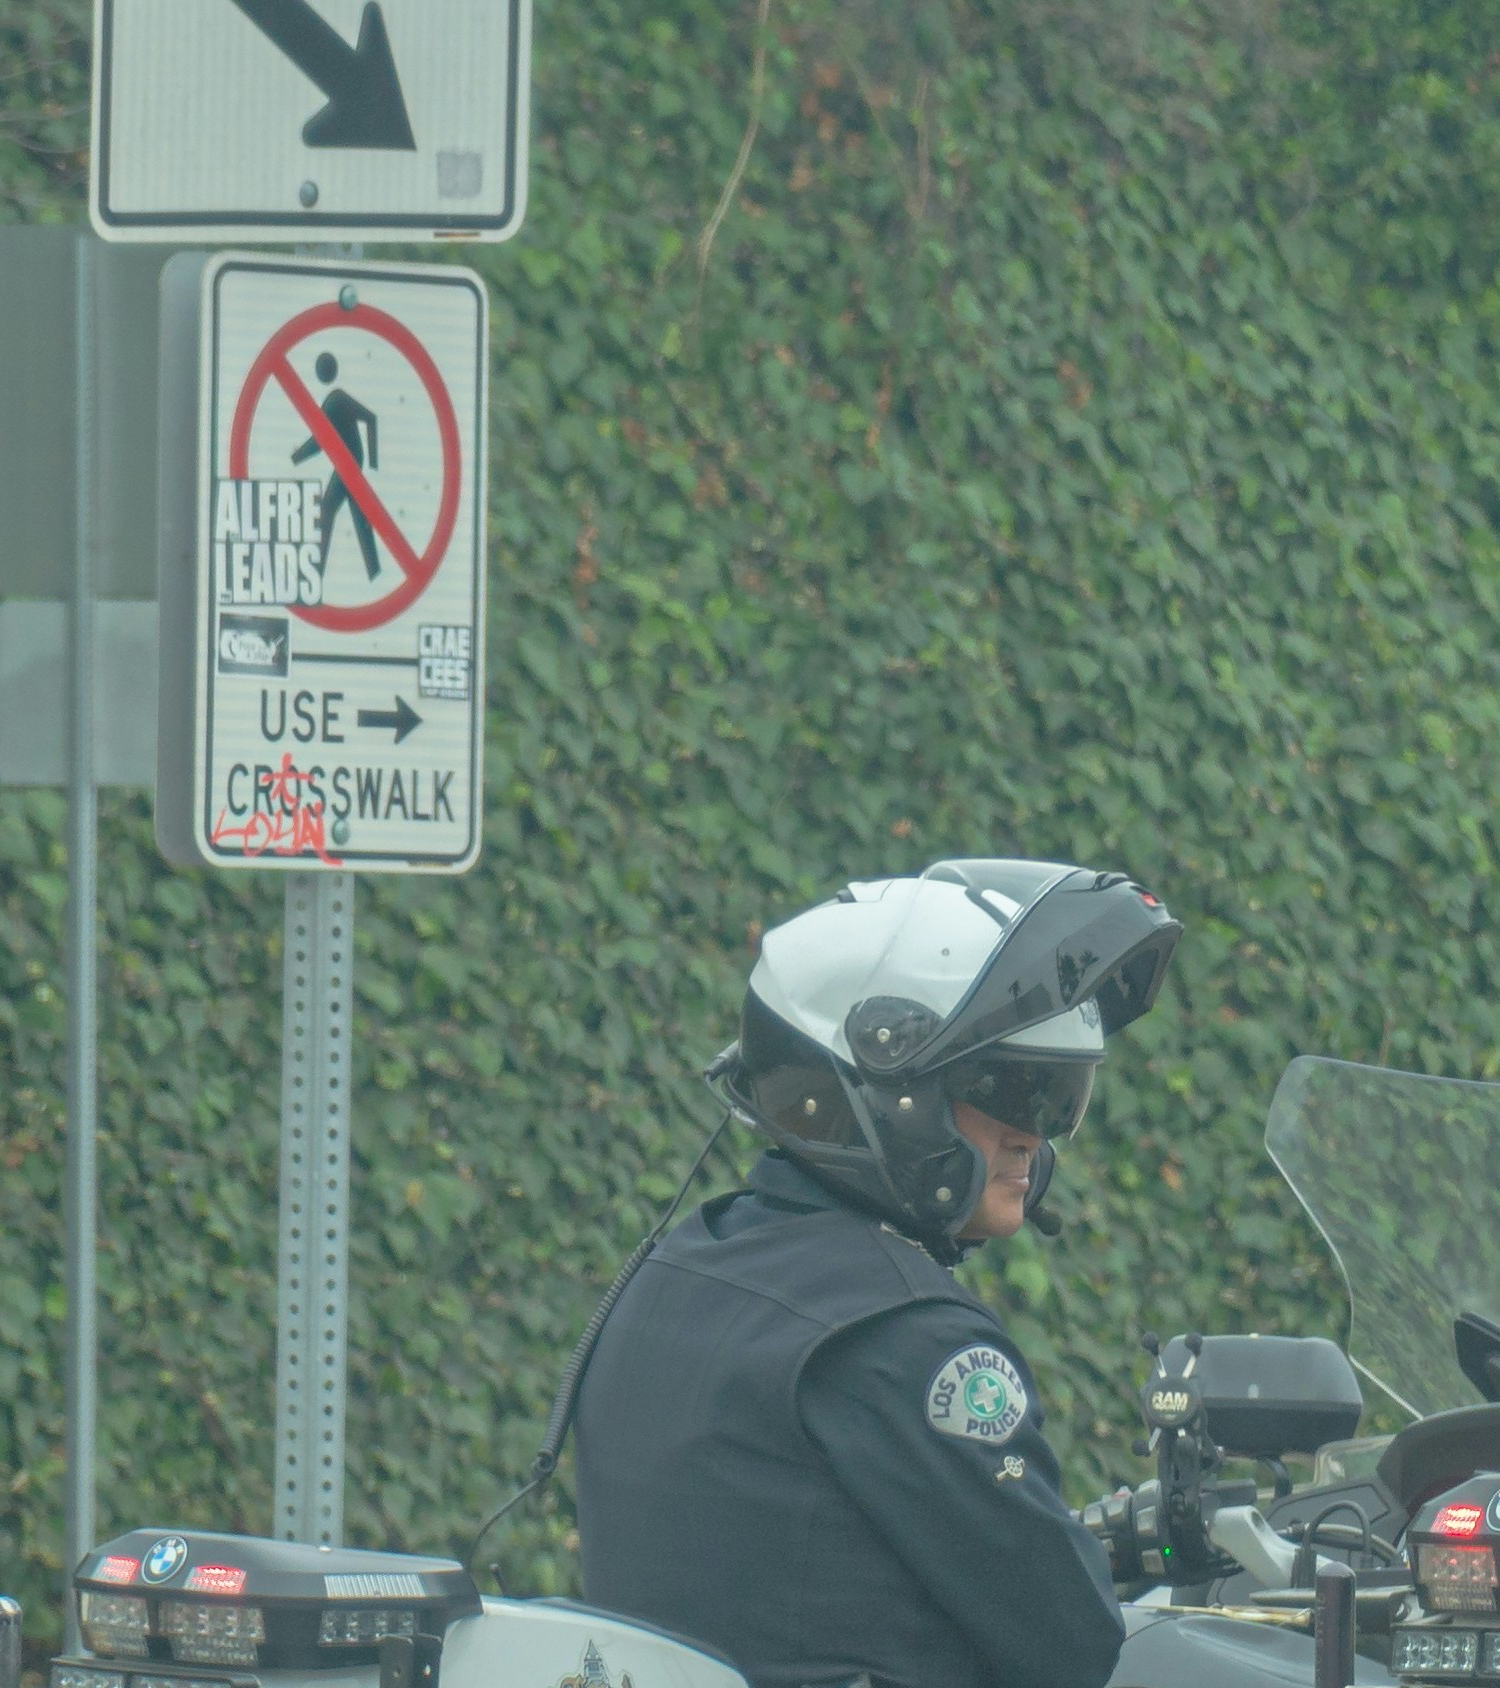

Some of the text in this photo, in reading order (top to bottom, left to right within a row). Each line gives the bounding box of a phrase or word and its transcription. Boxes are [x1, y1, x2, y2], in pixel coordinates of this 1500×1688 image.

[216, 481, 322, 543] ALFRE
[215, 542, 323, 605] LEADS
[261, 689, 345, 743] USE
[227, 763, 455, 823] CROSSWALK
[932, 1351, 1023, 1419] LOS ANGELES
[966, 1404, 1021, 1436] POLICE
